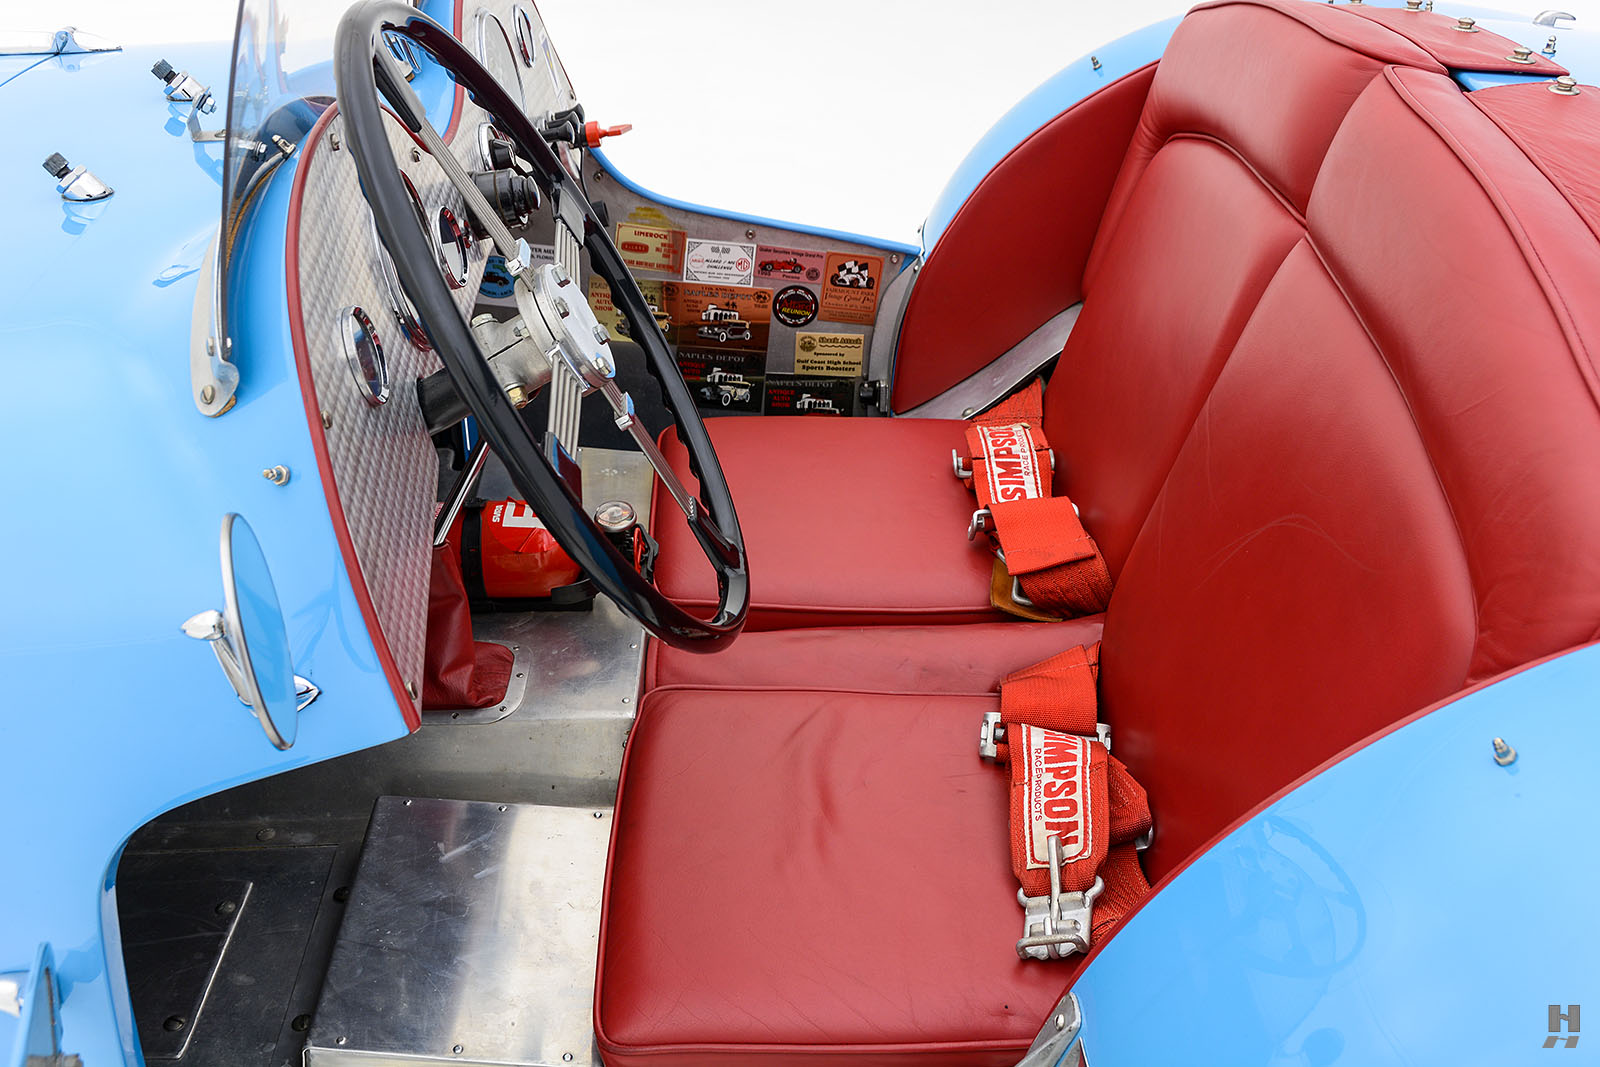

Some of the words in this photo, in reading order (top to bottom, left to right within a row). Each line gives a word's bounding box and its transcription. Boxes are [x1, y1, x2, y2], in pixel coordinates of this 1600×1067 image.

[634, 230, 668, 240] LIMEROCK
[737, 259, 750, 271] MG
[684, 289, 719, 297] NAPLES
[782, 307, 810, 316] REUNION
[678, 352, 713, 360] NAPLES
[988, 428, 1027, 500] SIMPSO
[1022, 455, 1030, 476] RACE
